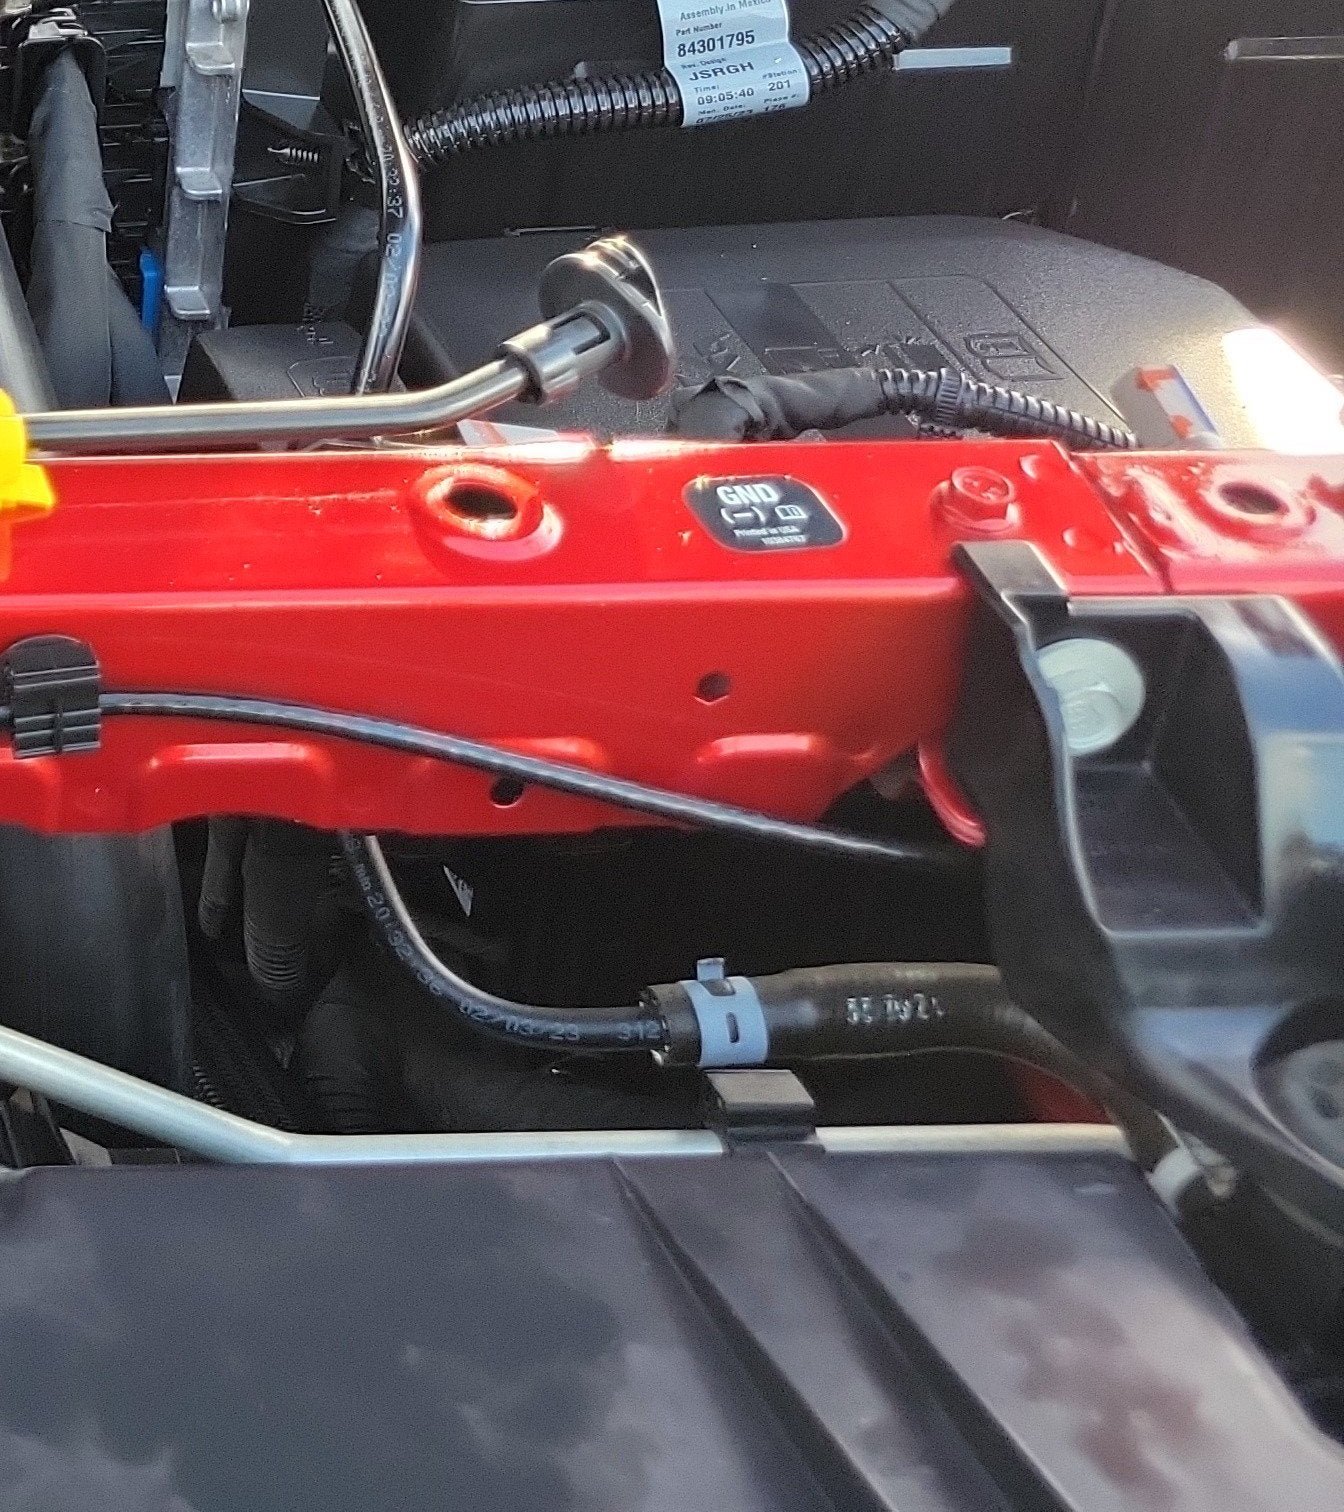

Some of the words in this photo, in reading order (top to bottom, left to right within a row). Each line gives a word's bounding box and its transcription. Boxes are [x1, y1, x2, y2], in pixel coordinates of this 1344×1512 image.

[675, 26, 692, 37] Part
[693, 21, 723, 34] Number
[676, 29, 756, 58] 84301795
[688, 61, 756, 82] JSRGH
[767, 79, 792, 92] 201
[696, 87, 755, 106] 09:05:40
[716, 482, 781, 505] GND
